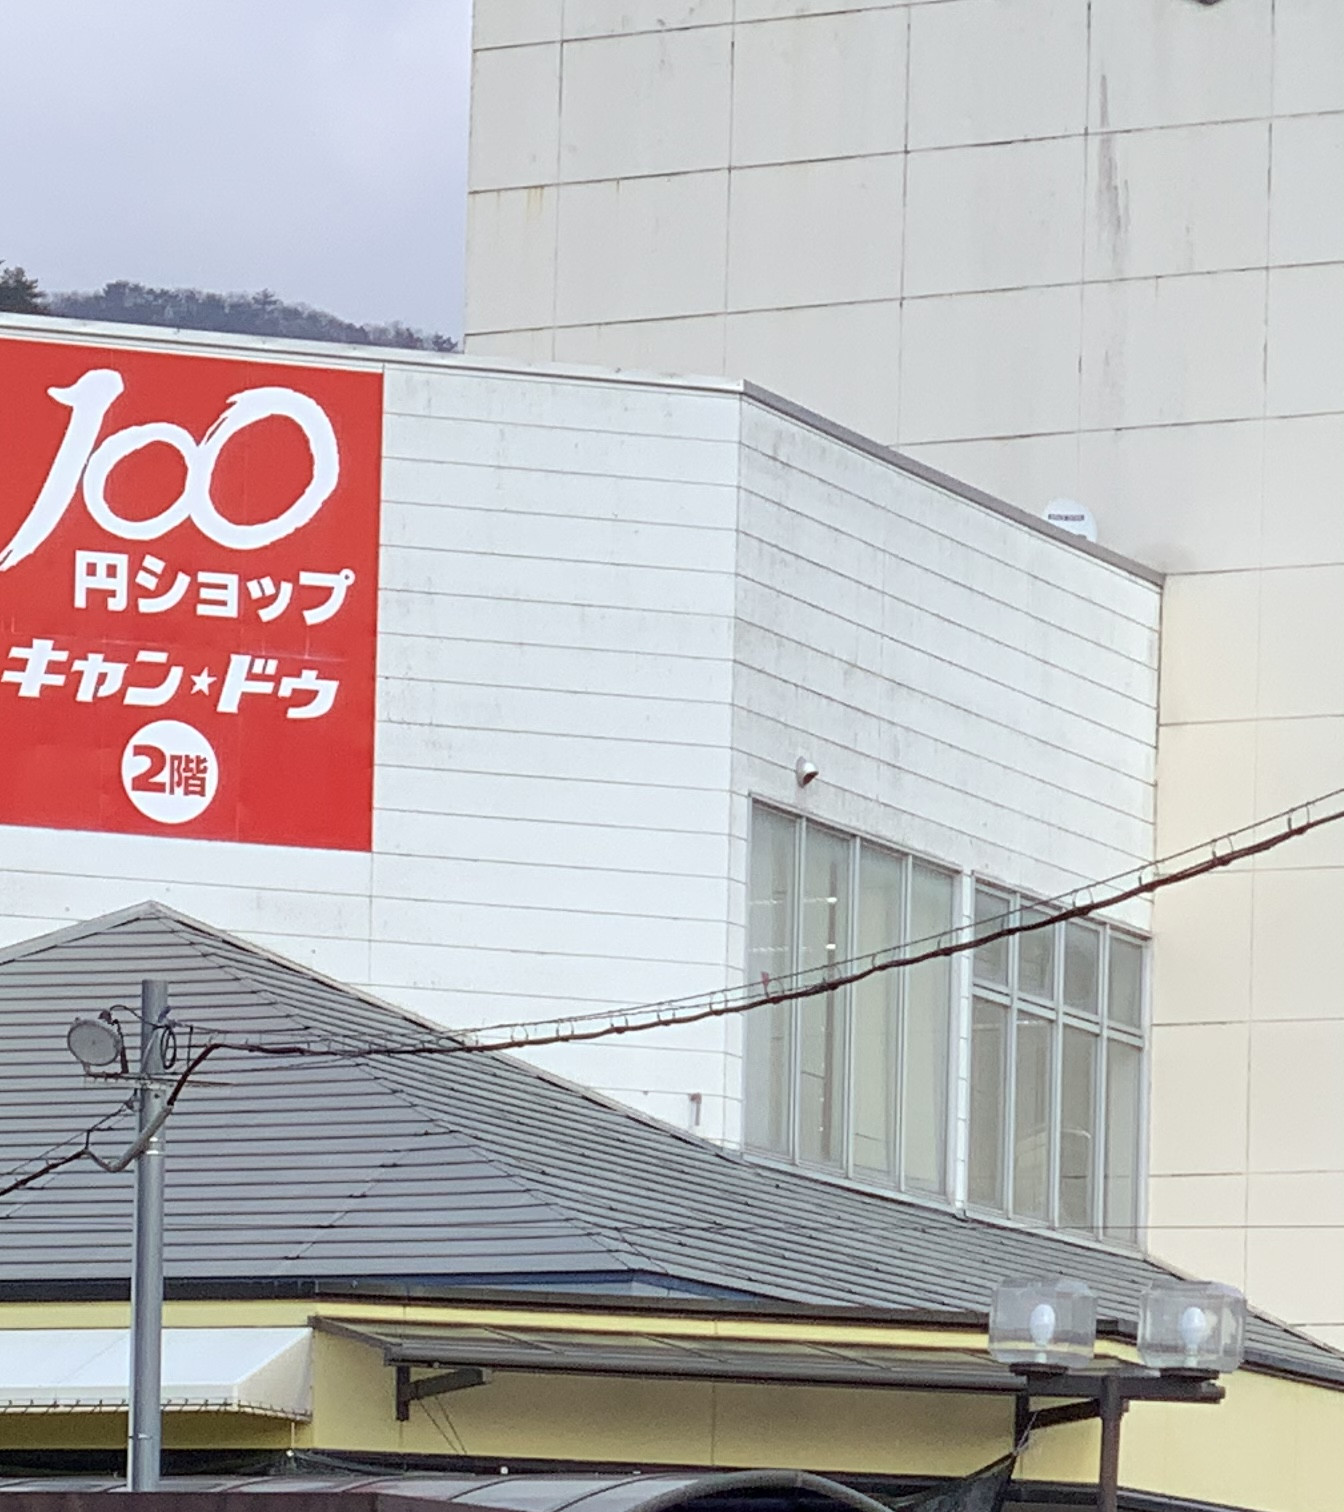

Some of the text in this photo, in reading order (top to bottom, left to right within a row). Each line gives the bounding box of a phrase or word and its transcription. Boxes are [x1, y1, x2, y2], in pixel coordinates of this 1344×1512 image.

[73, 549, 356, 626] 円ショップ
[130, 743, 210, 799] 2階
